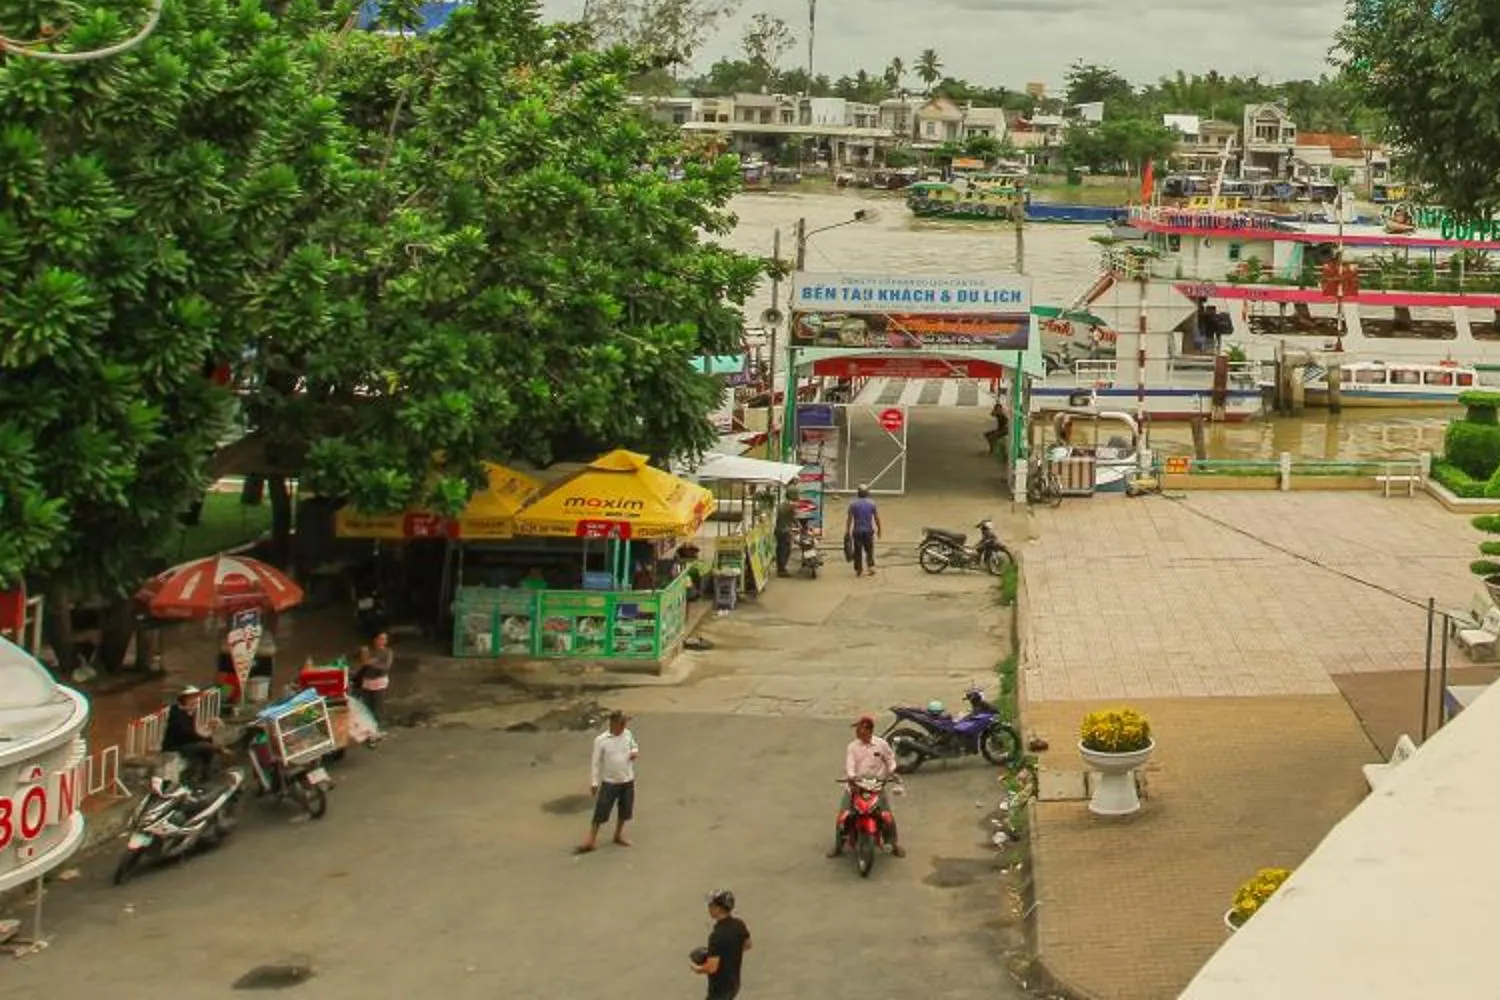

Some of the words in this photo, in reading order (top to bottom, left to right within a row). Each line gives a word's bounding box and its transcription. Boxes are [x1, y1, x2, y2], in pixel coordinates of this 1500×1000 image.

[801, 283, 837, 301] BẾN
[940, 288, 952, 303] &
[957, 289, 979, 303] DU
[563, 496, 644, 510] maxim
